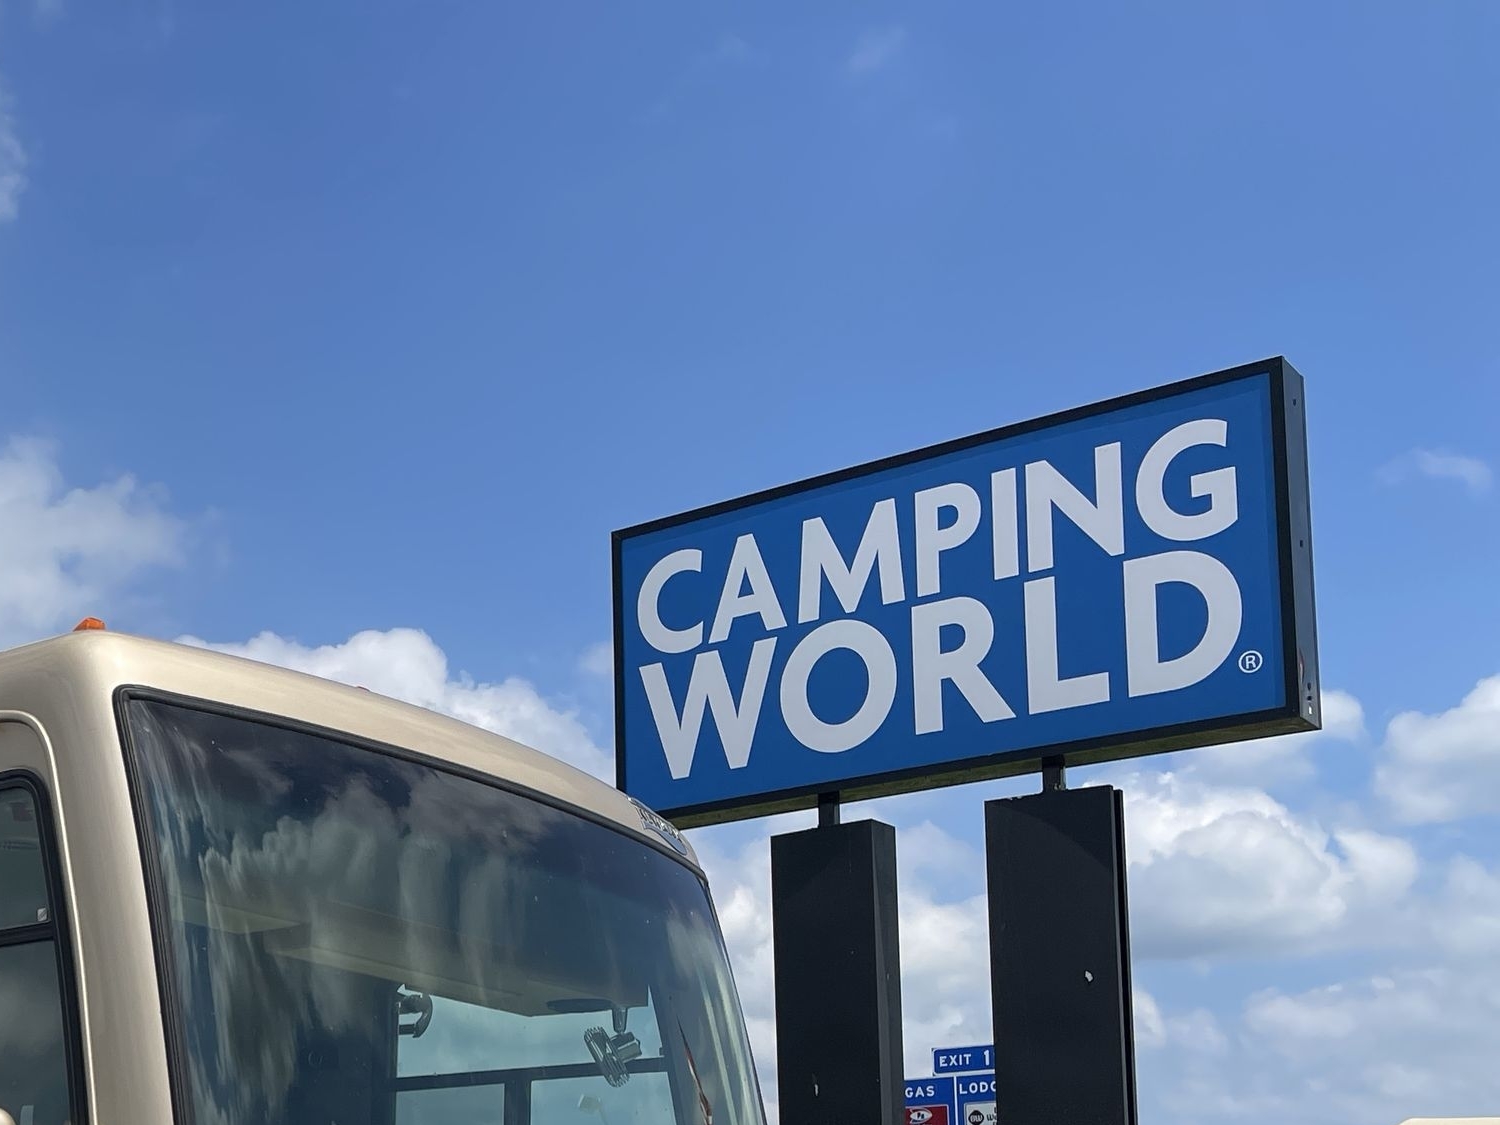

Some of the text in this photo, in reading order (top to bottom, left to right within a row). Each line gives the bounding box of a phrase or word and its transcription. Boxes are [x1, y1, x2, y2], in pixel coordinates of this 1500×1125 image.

[637, 418, 1239, 655] CAMPING
[939, 1053, 972, 1068] EXIT
[904, 1085, 935, 1098] GAS
